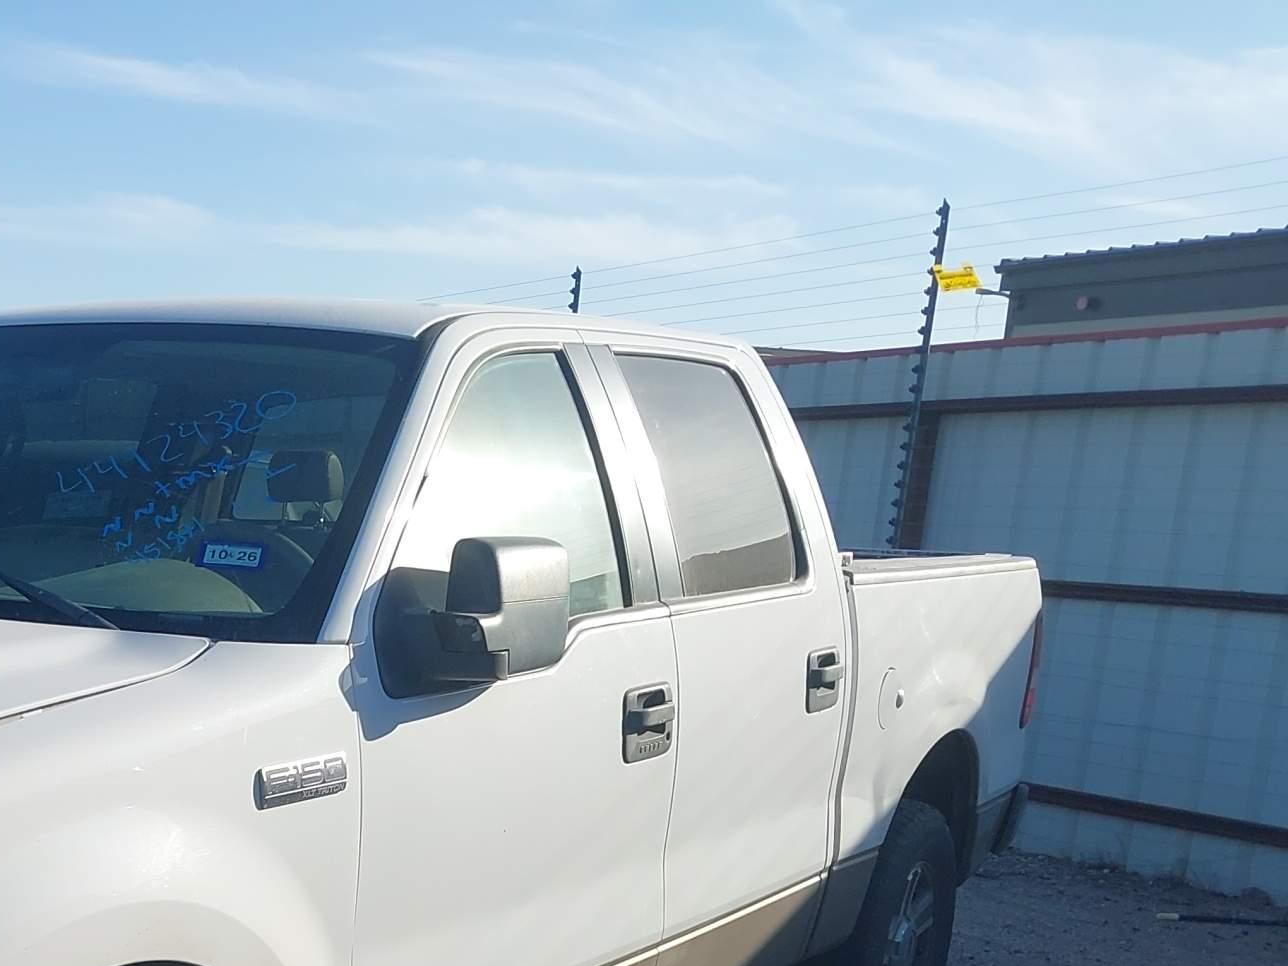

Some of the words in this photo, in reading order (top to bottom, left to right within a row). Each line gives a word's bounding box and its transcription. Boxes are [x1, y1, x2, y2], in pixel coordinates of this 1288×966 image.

[56, 390, 297, 494] 44124320
[209, 549, 228, 560] 10
[236, 551, 257, 562] 26
